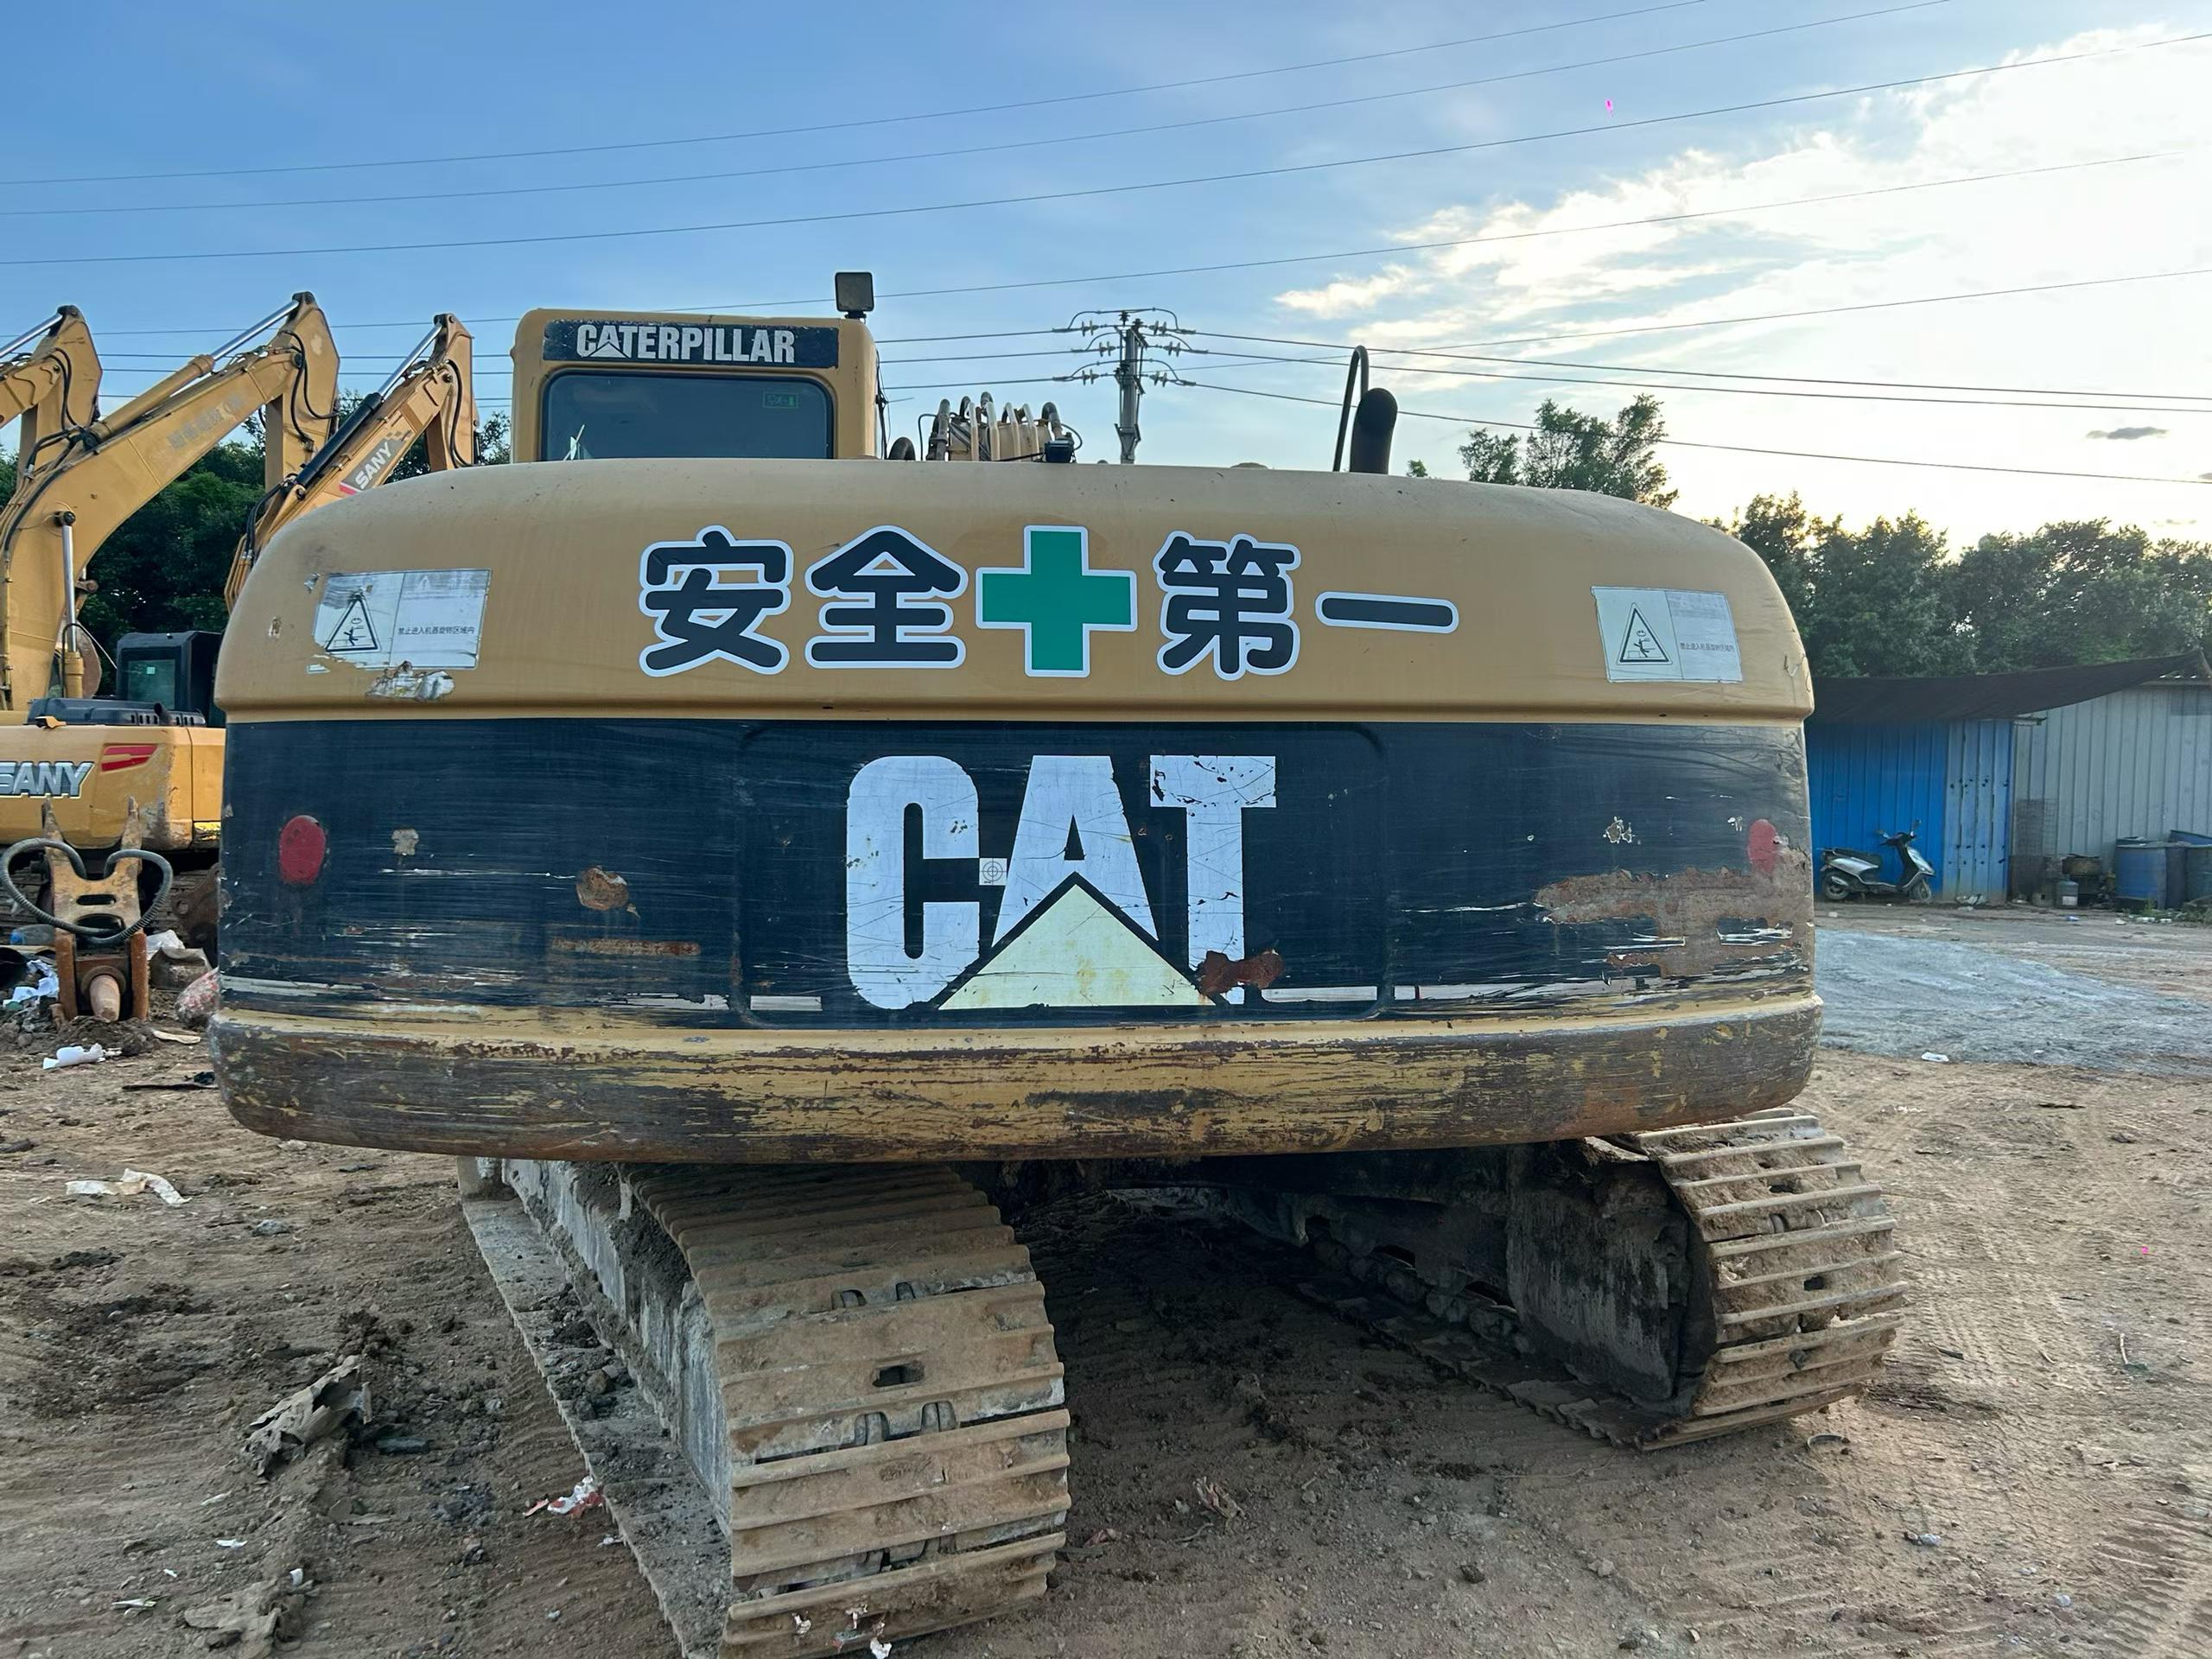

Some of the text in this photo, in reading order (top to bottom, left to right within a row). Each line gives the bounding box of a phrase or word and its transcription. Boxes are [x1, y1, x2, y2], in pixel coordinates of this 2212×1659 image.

[576, 324, 795, 363] CATERPILLAR
[355, 442, 391, 489] SANY
[639, 524, 1460, 681] 安全 第一
[846, 754, 1277, 1010] CAT
